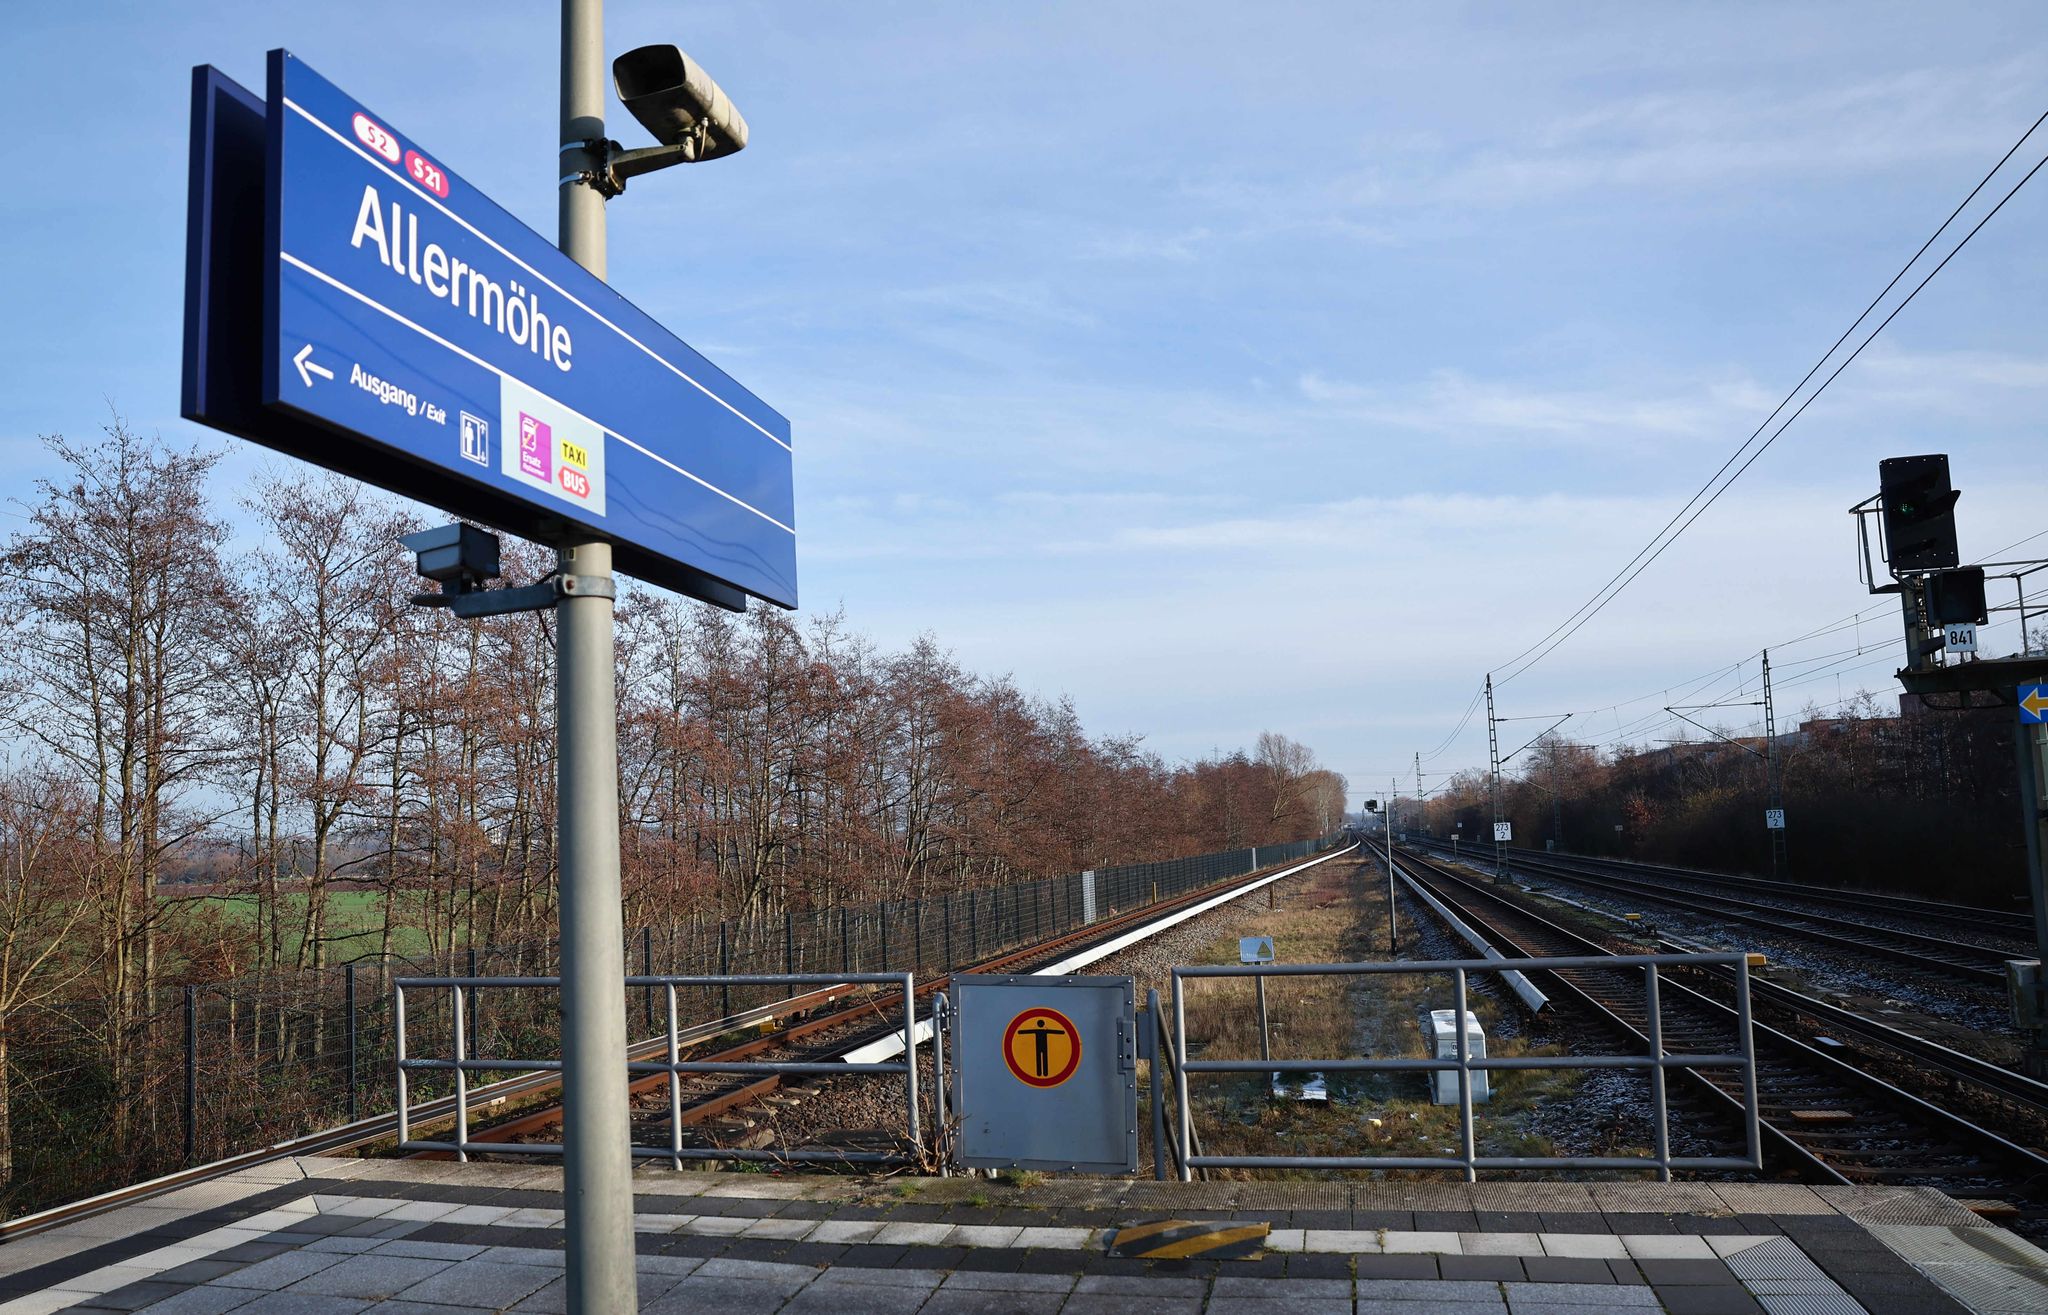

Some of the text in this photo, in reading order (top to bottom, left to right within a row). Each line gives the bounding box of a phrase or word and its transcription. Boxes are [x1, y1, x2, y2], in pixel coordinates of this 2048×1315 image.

[414, 157, 441, 192] S21
[351, 185, 572, 372] Allermöhe
[350, 364, 418, 417] Ausgang
[427, 404, 447, 426] Exit
[563, 443, 586, 466] TAXI
[563, 470, 586, 494] BUS
[1950, 629, 1972, 645] 841
